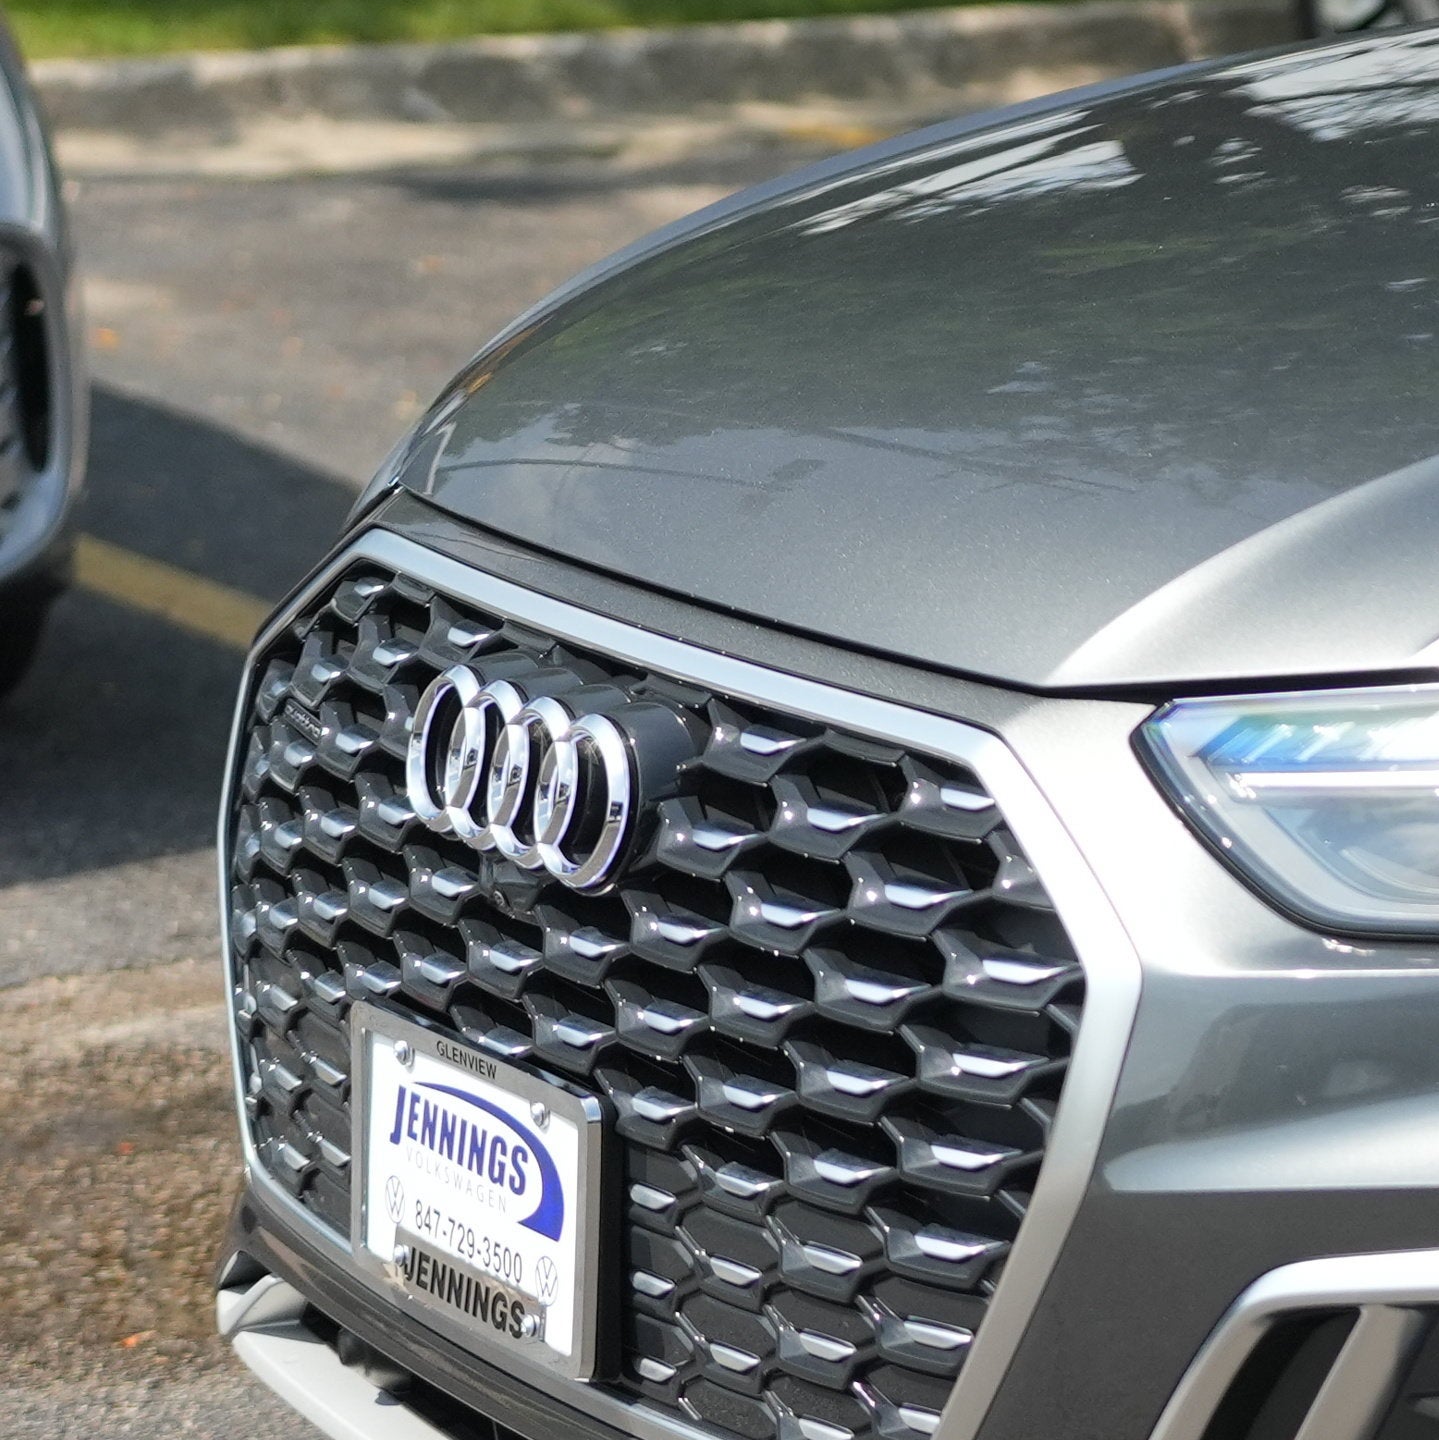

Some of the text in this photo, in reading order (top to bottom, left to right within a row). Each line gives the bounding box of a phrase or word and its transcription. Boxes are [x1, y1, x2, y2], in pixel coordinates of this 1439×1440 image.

[435, 1039, 498, 1080] GLENVIEW
[389, 1085, 530, 1196] JENNINGS
[405, 1147, 508, 1214] VOLKSWAGEN
[415, 1200, 523, 1284] 847-729-3500
[404, 1246, 525, 1340] JENNINGS
